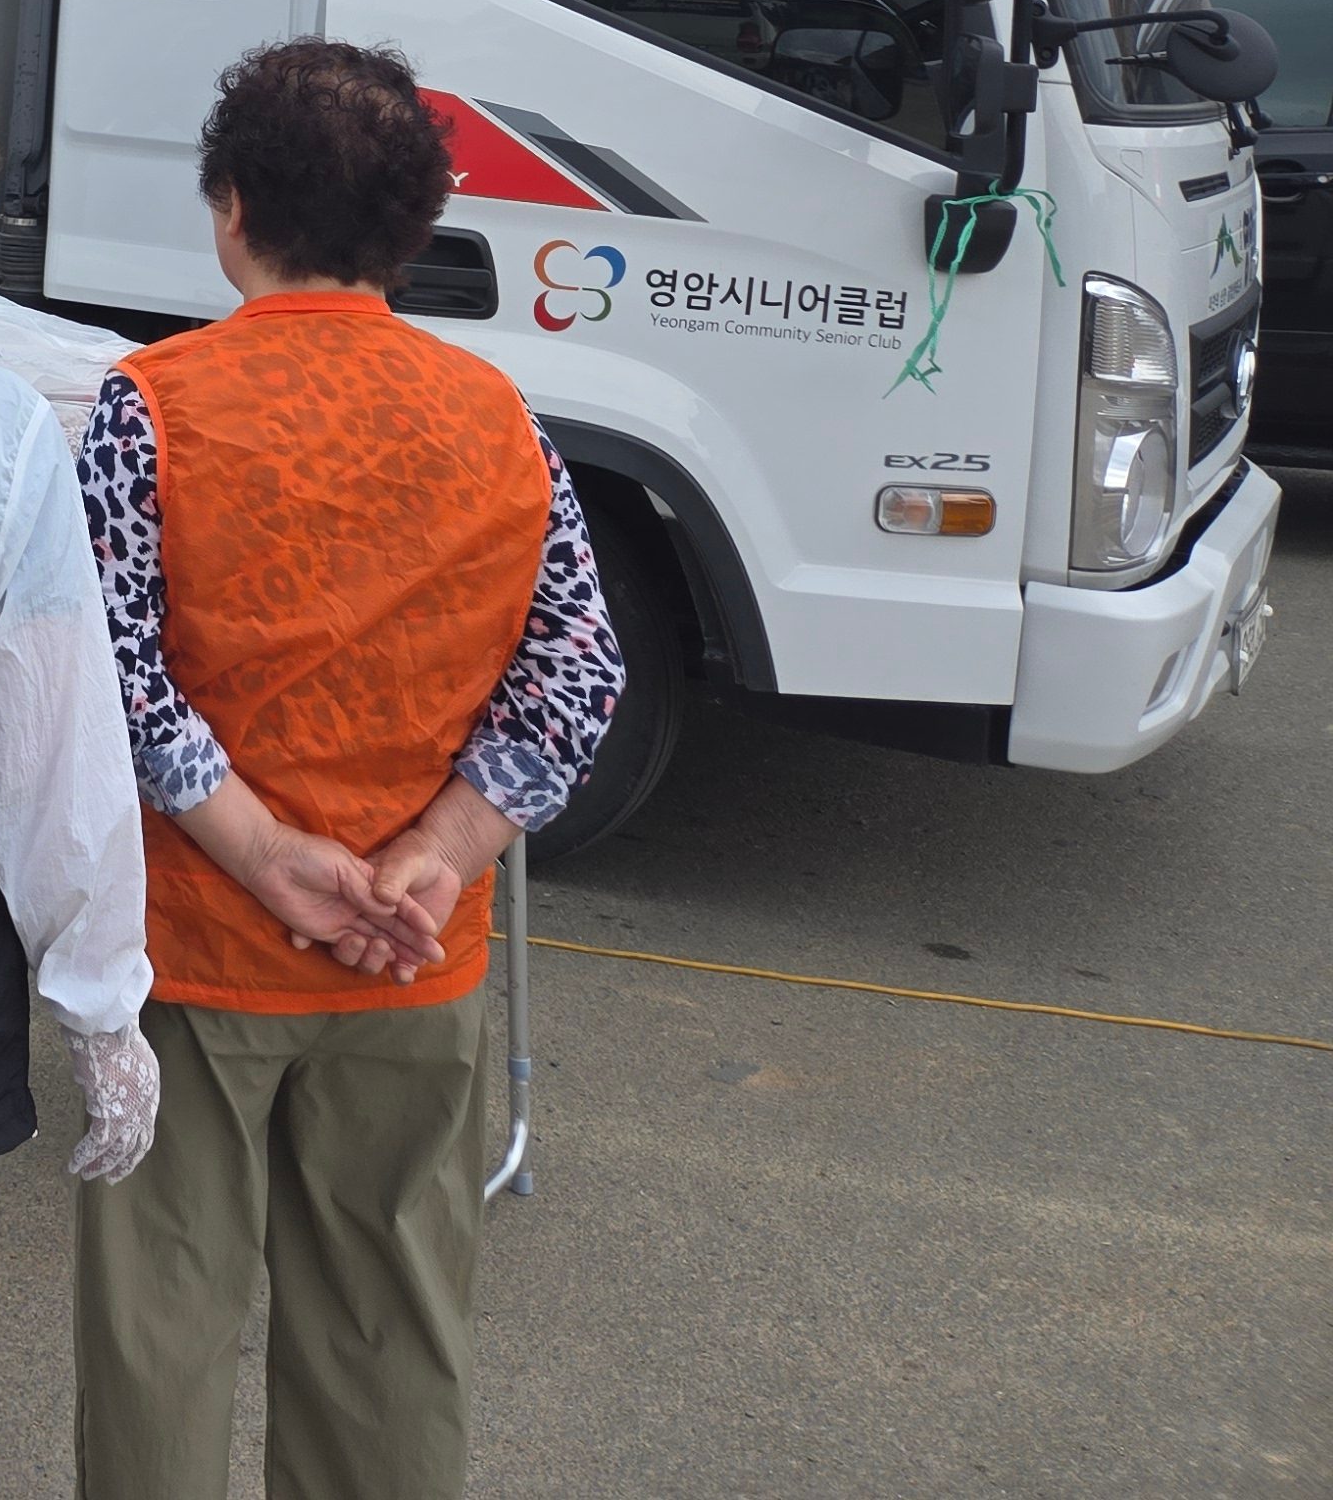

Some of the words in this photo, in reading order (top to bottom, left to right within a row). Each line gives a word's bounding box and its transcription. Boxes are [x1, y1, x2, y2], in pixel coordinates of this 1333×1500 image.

[645, 268, 908, 330] 영암시니어클럽
[650, 312, 720, 333] Yeongam
[724, 319, 812, 344] Community
[814, 328, 864, 346] Senior
[868, 333, 902, 350] Club
